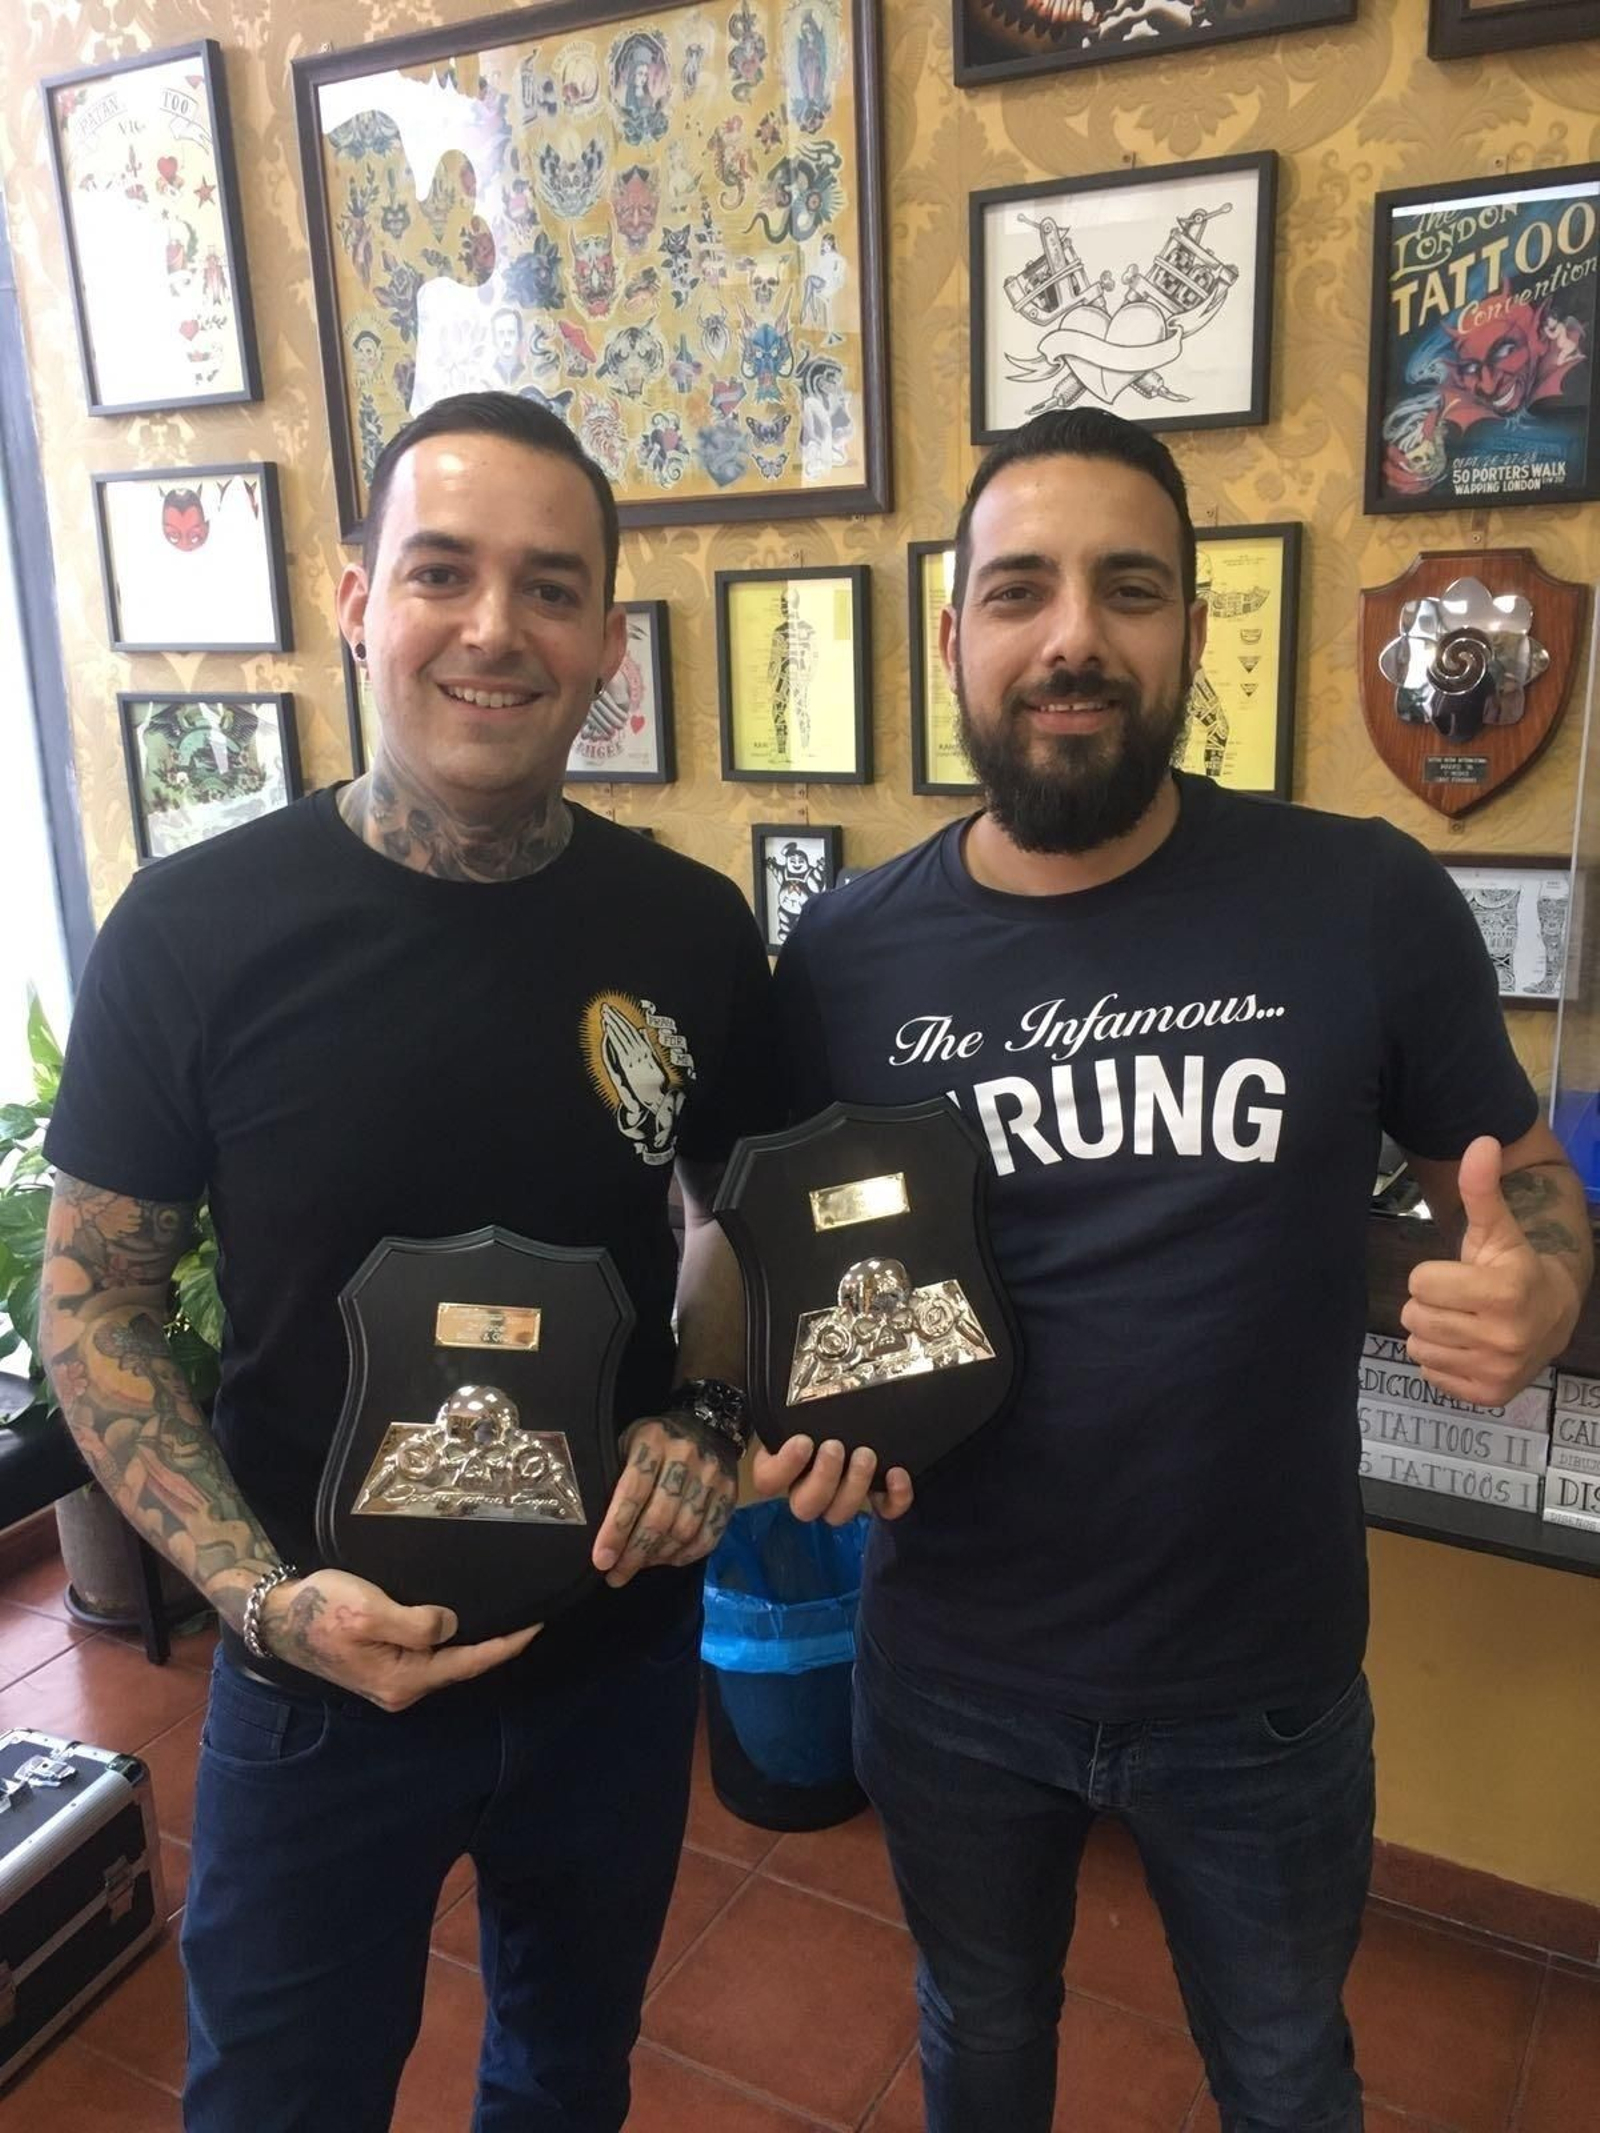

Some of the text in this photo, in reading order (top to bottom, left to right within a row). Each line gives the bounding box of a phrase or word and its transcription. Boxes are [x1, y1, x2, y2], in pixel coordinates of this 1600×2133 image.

[1390, 202, 1518, 281] LONDON
[1391, 201, 1597, 336] TATTOO
[1457, 255, 1598, 335] Convention
[1452, 469, 1470, 484] 50
[1472, 465, 1529, 482] PORTERS
[1531, 461, 1566, 477] WALK
[1454, 481, 1500, 496] WAPPING
[1502, 478, 1541, 493] LONDON
[888, 992, 1286, 1066] The Infamous...
[945, 1055, 1287, 1177] RUNG
[1376, 1409, 1494, 1459] TATTOOS
[1381, 1455, 1511, 1504] TATTOOS
